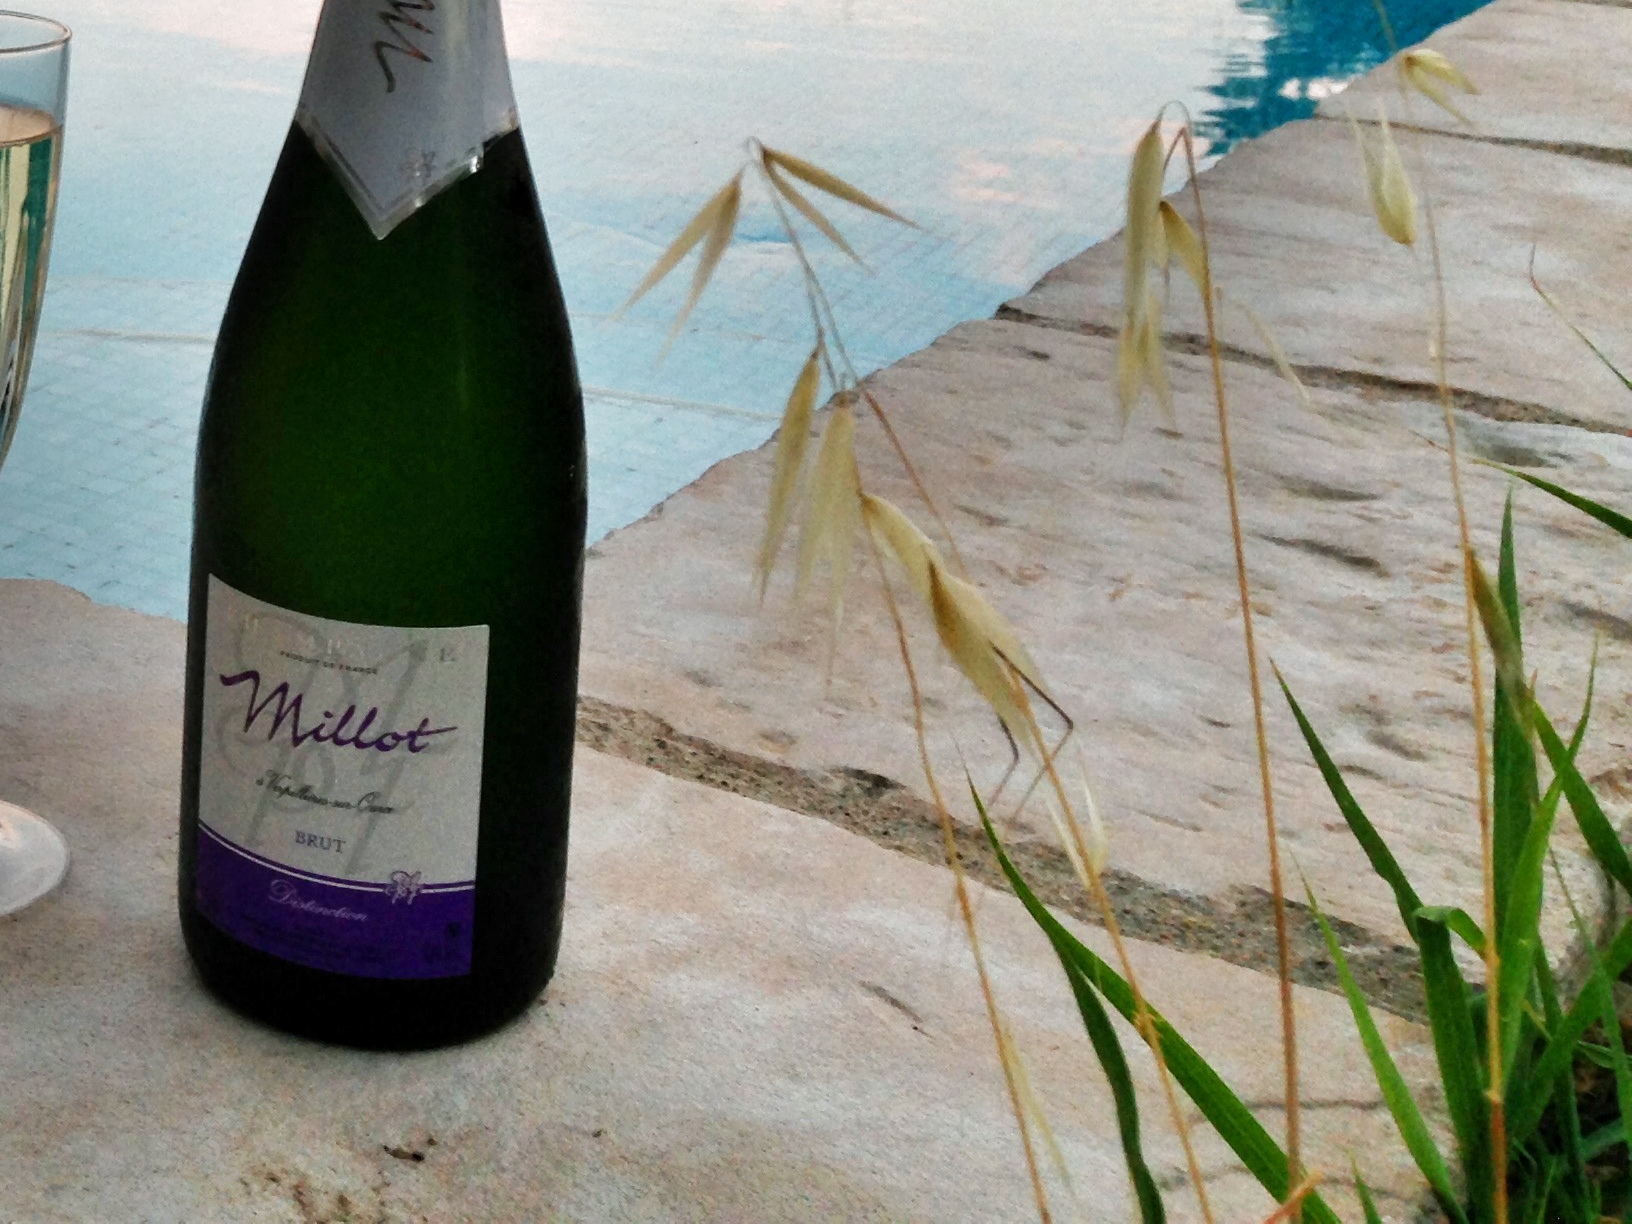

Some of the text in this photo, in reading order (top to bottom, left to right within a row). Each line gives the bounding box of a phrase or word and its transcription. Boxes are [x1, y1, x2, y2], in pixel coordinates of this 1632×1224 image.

[219, 669, 458, 753] Millot
[295, 829, 346, 854] BRUT
[268, 879, 368, 922] Distinction
